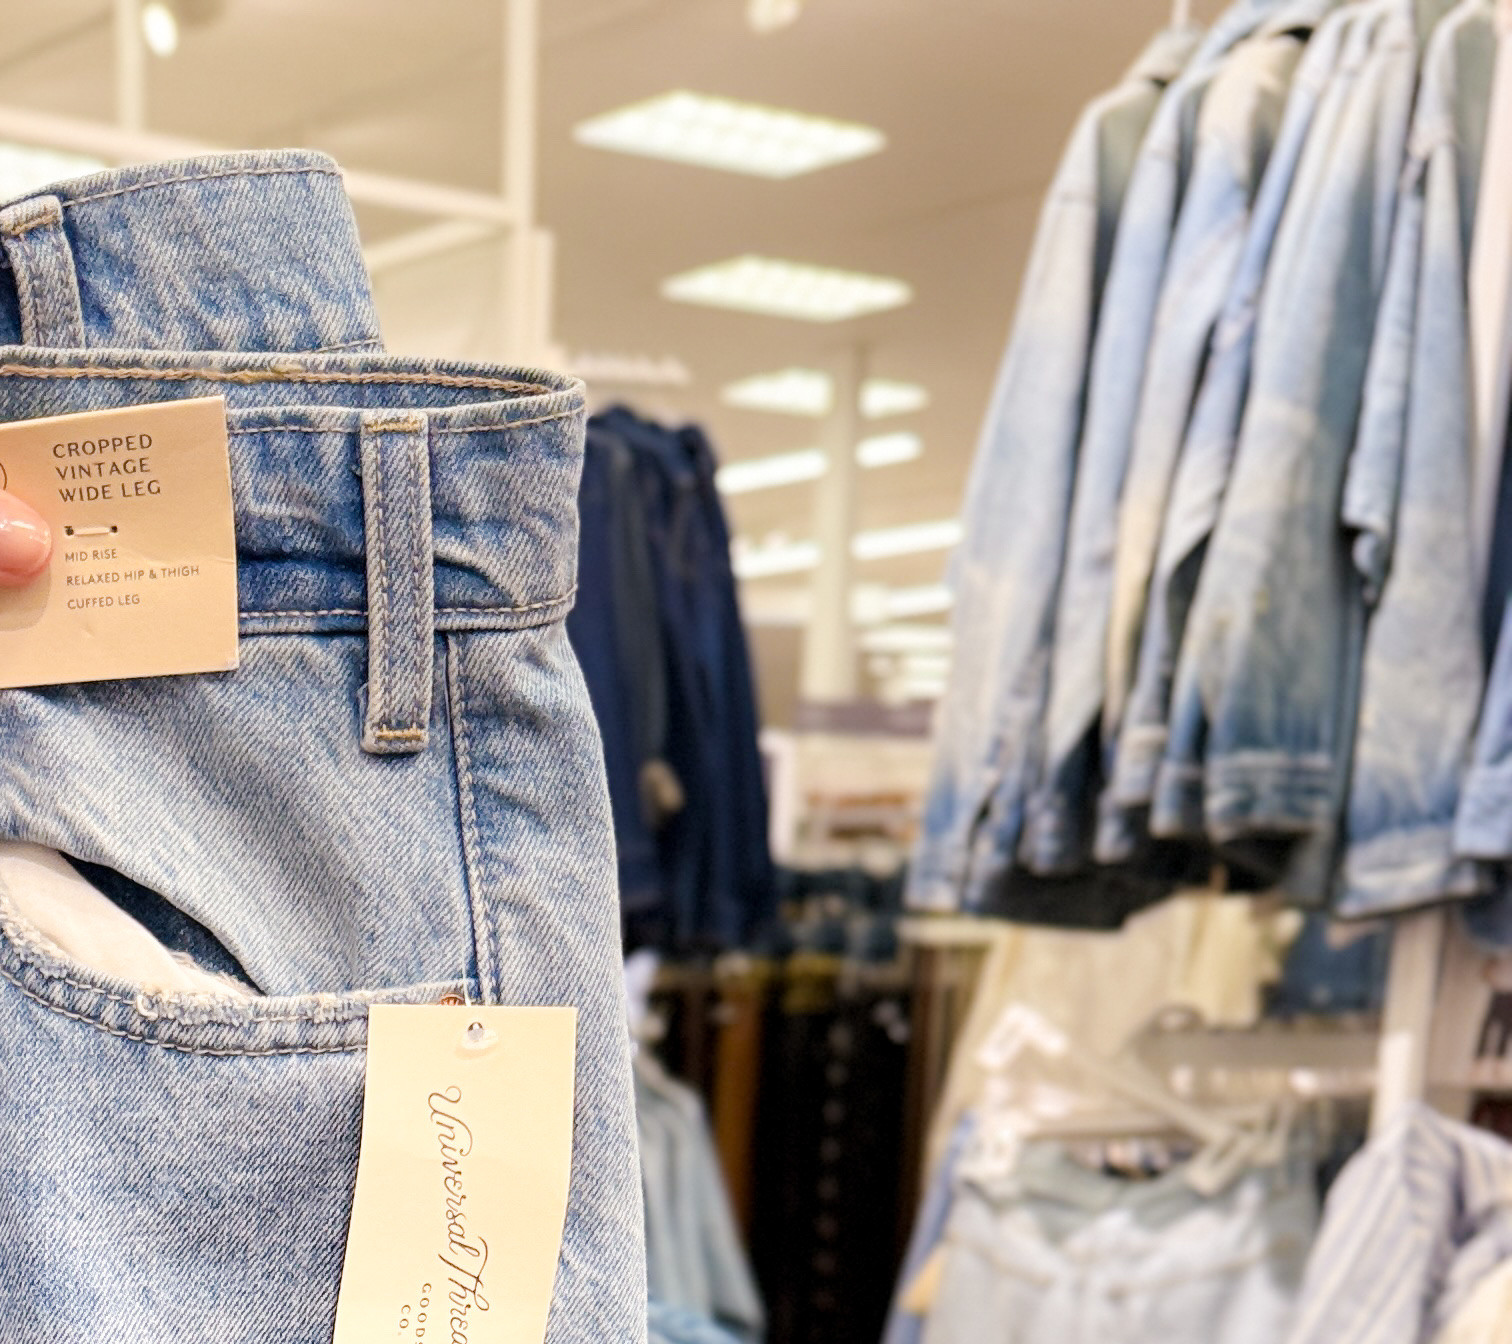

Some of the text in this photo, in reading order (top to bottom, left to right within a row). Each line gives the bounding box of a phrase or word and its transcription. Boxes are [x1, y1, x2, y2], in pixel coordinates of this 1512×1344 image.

[52, 433, 153, 458] CROPPED
[55, 456, 151, 480] VINTAGE
[58, 479, 161, 503] WIDE LEG
[65, 548, 118, 562] MID RISE
[66, 565, 200, 586] RELAXED HIP & THIGH
[67, 594, 140, 610] CUFFED LEG
[428, 1085, 480, 1257] Universal
